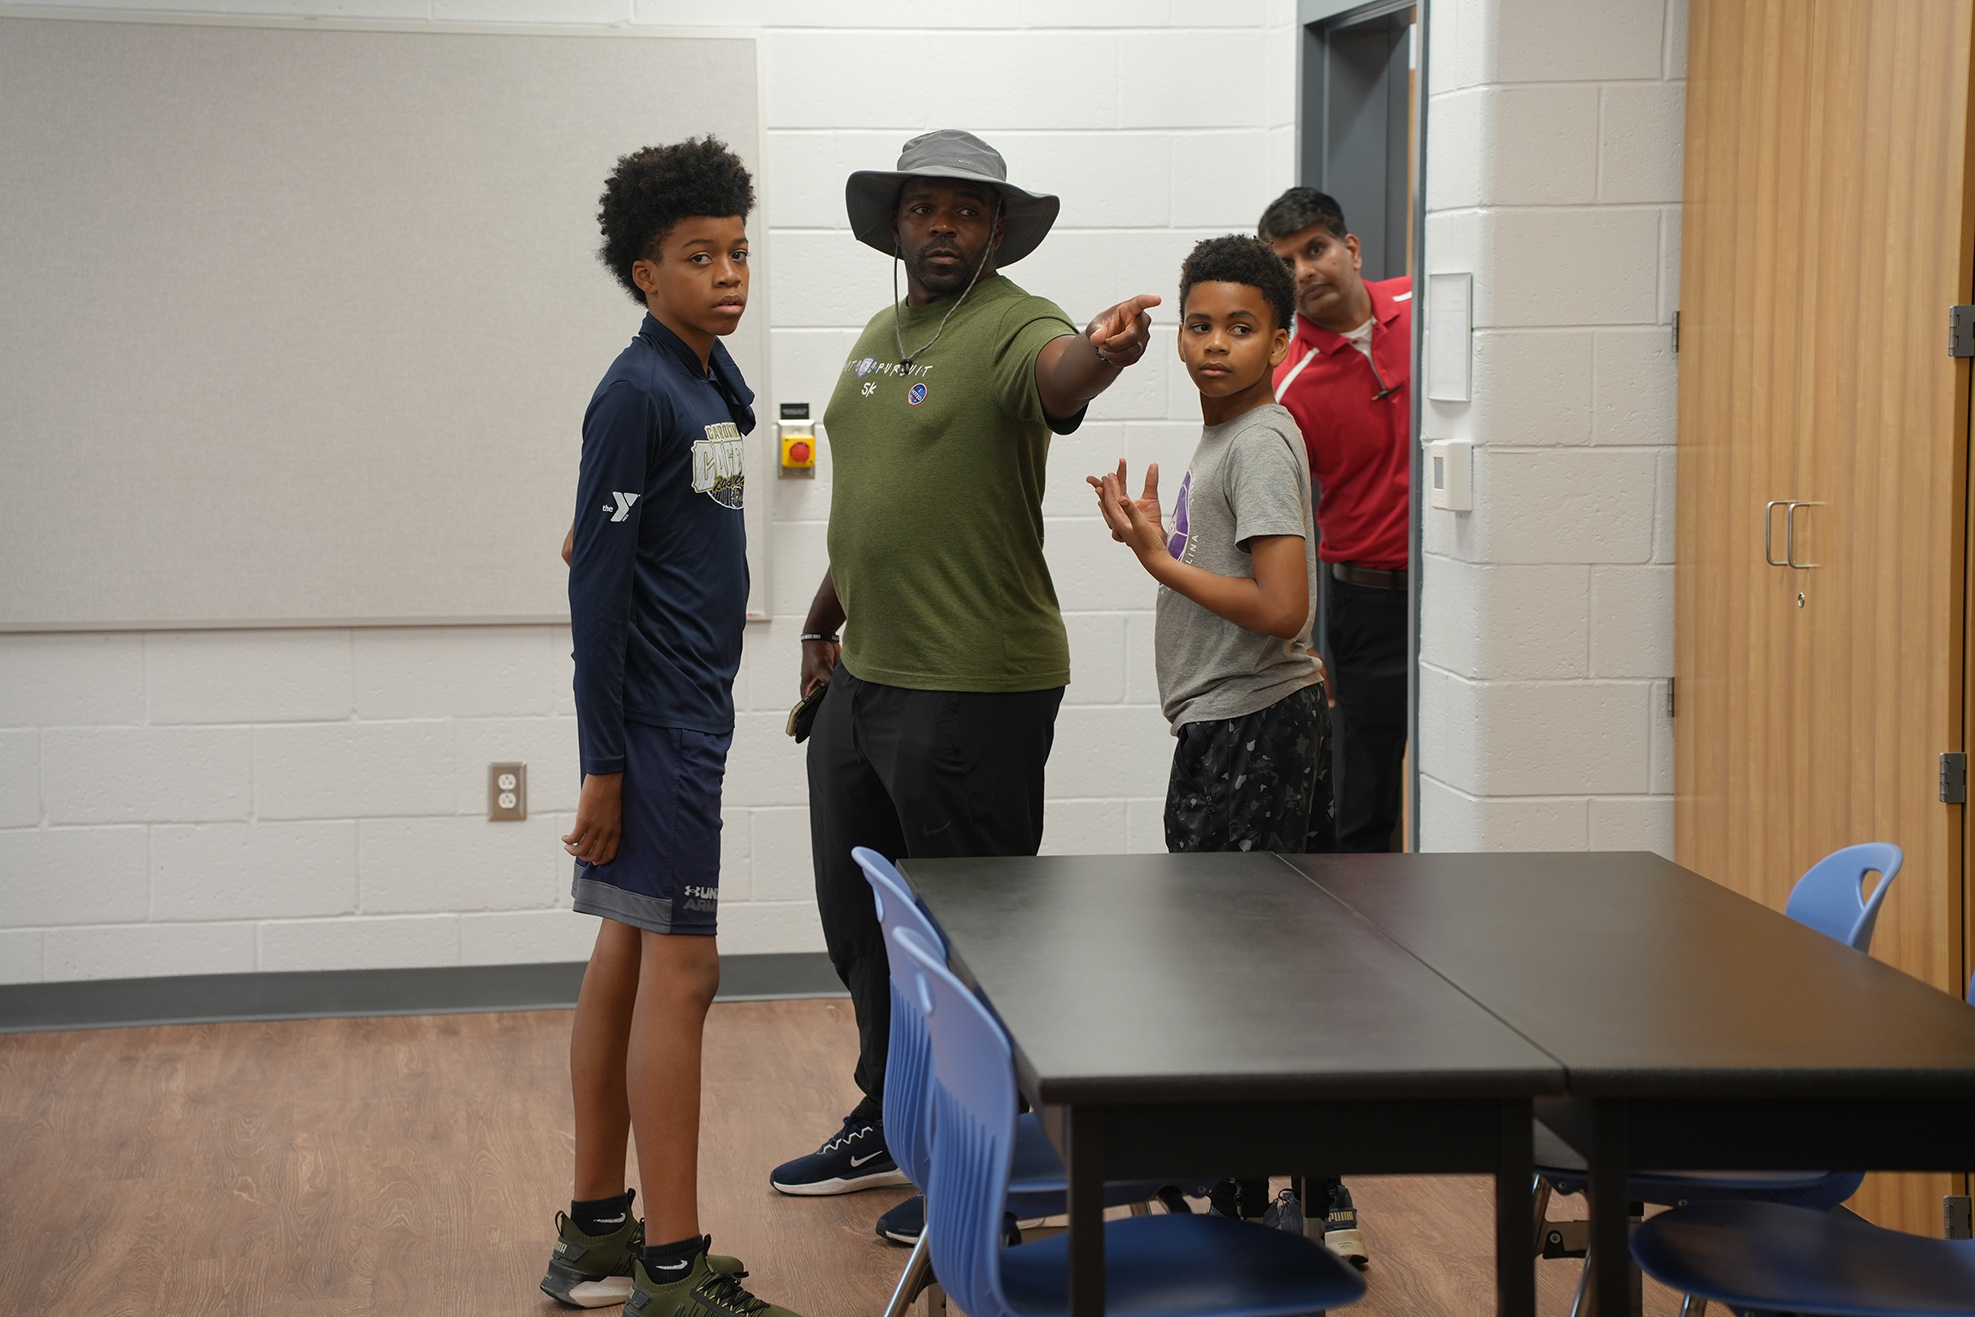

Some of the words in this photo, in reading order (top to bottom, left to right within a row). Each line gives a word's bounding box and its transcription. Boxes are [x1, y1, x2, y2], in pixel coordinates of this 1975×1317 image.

[602, 504, 614, 513] the
[1185, 534, 1199, 565] LINA
[1328, 1211, 1354, 1223] PUMA
